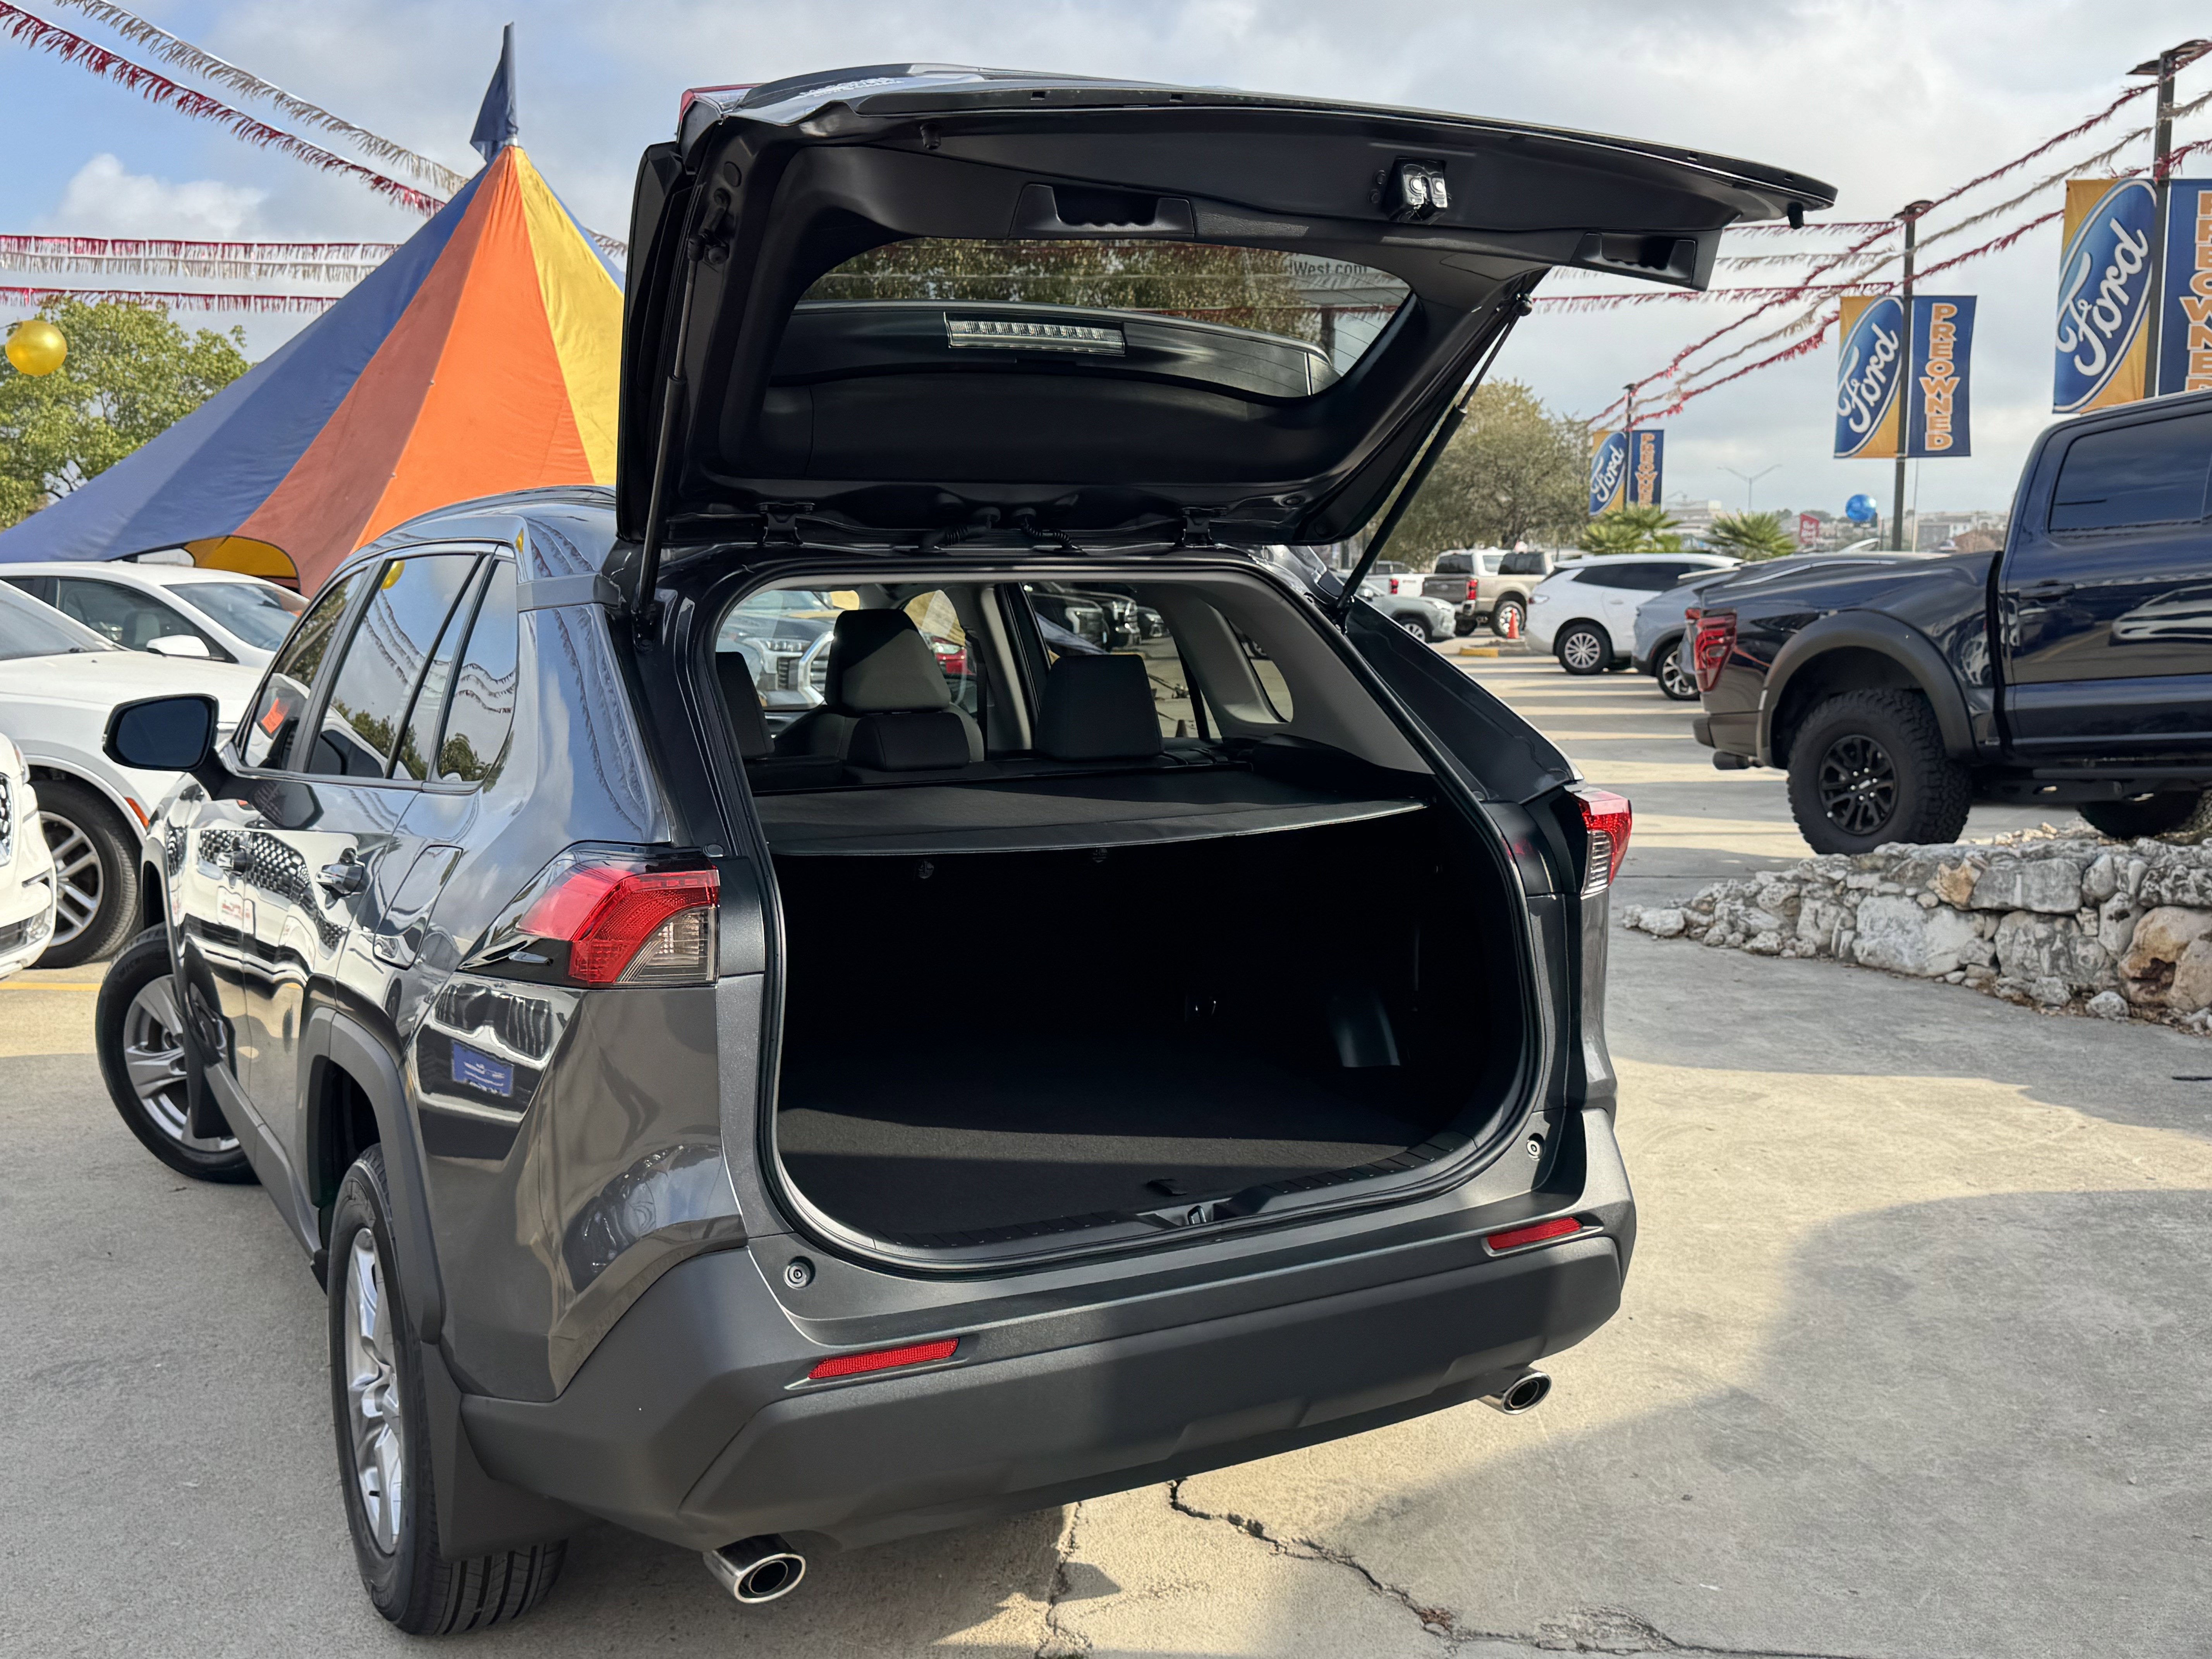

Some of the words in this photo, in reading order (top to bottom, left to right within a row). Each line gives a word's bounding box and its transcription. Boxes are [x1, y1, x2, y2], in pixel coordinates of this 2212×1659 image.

[2056, 218, 2148, 376] Ford
[1837, 322, 1899, 433] Ford
[1919, 303, 1961, 451] PREOWNED
[1590, 444, 1625, 503] Ford
